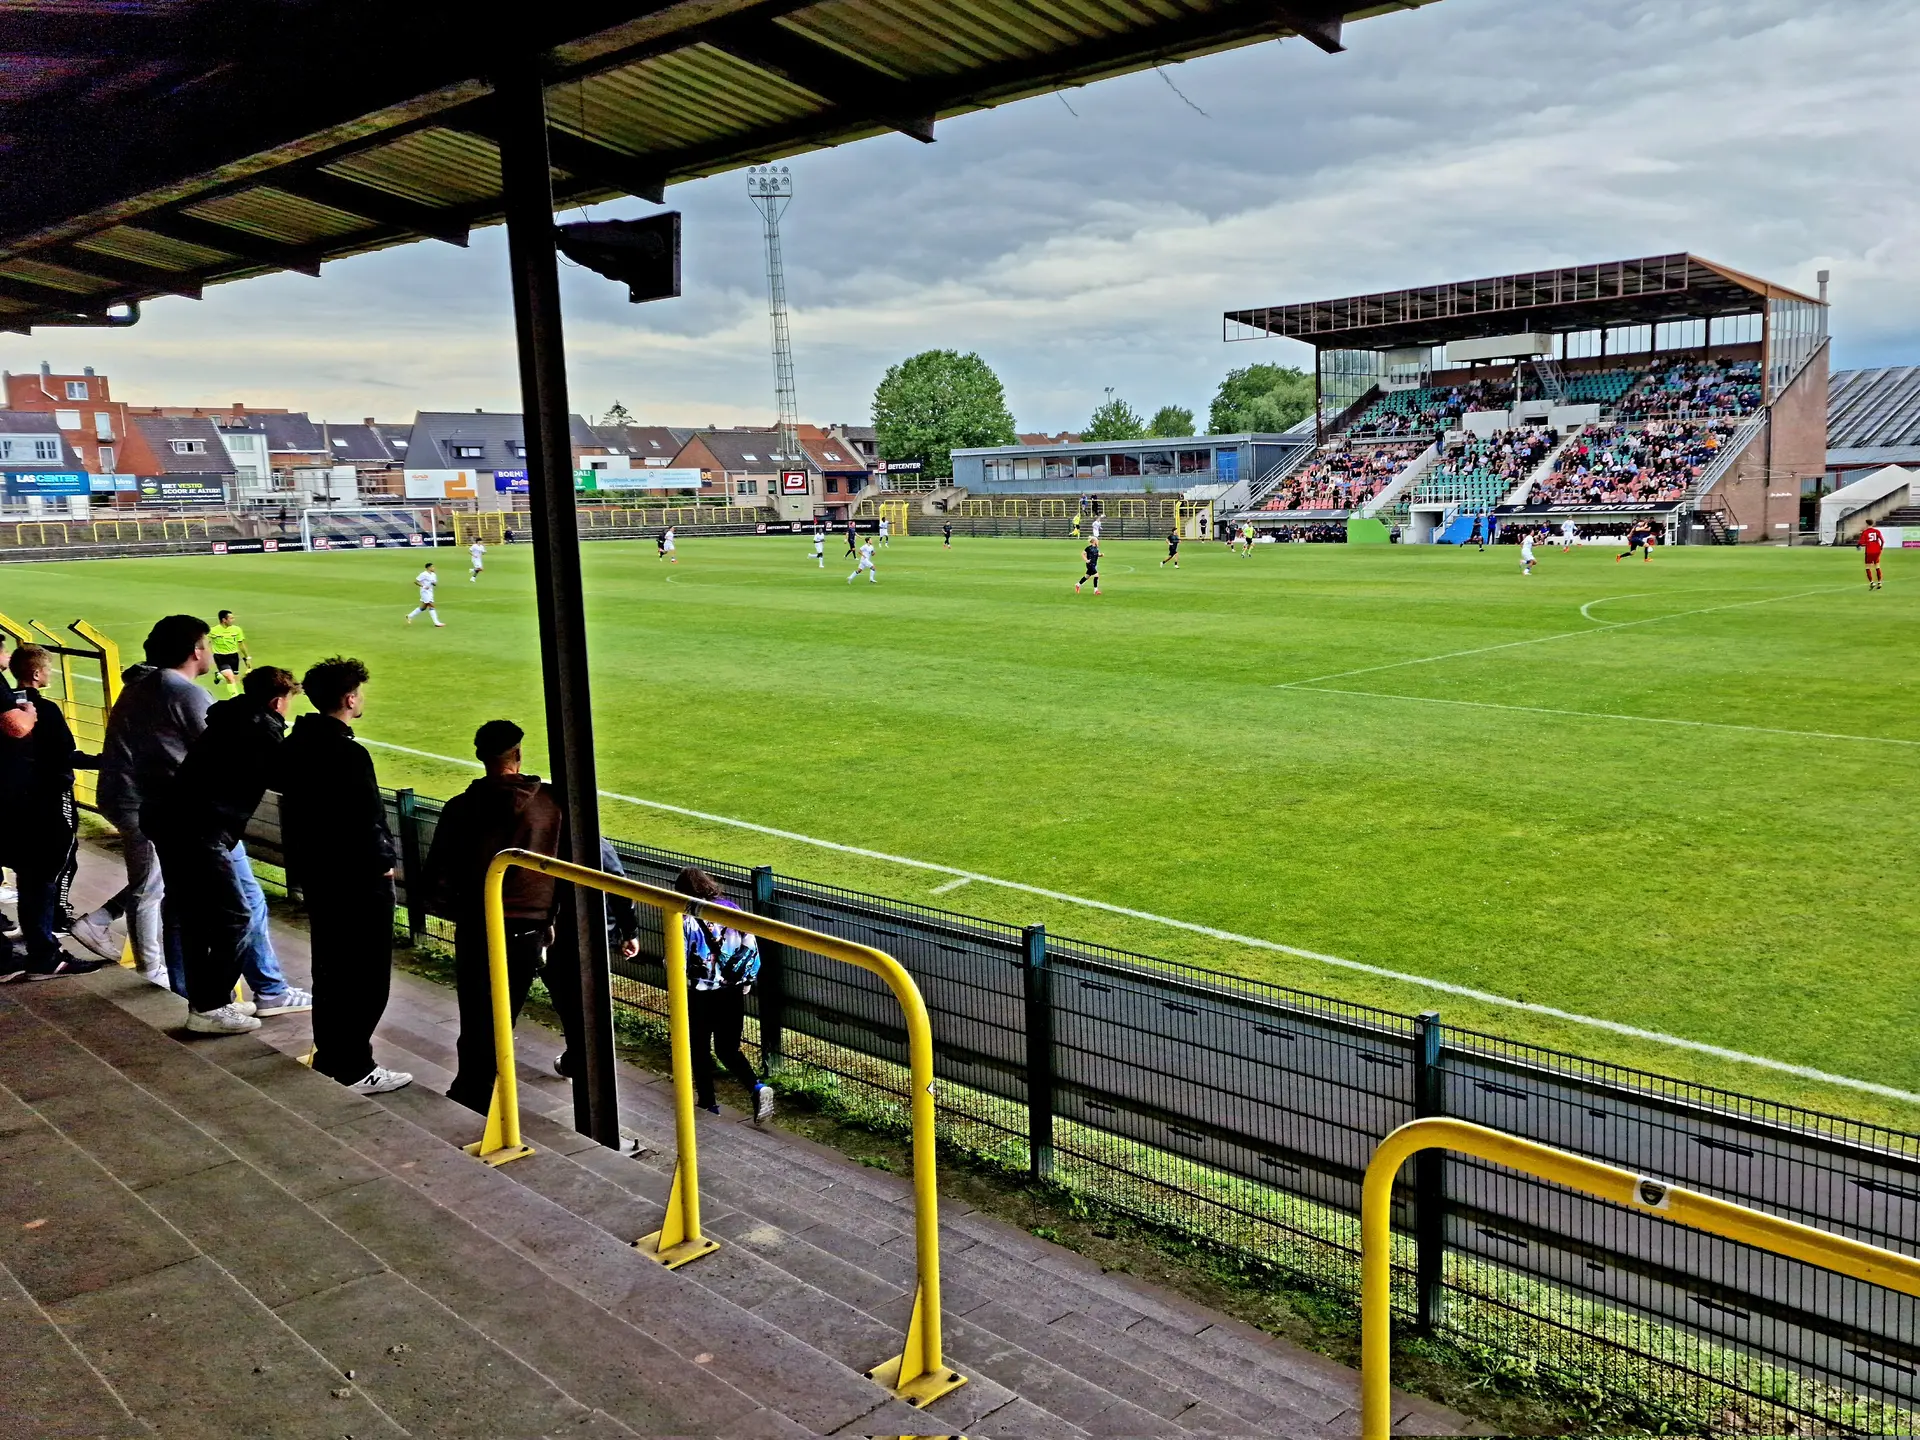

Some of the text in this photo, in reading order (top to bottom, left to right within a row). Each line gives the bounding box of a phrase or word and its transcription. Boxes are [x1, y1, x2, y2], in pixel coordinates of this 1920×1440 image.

[888, 462, 921, 470] BETCENTER
[16, 474, 79, 483] LAS CENTER
[786, 474, 804, 487] B
[1547, 503, 1656, 512] BETCENTER
[1868, 532, 1877, 542] 51
